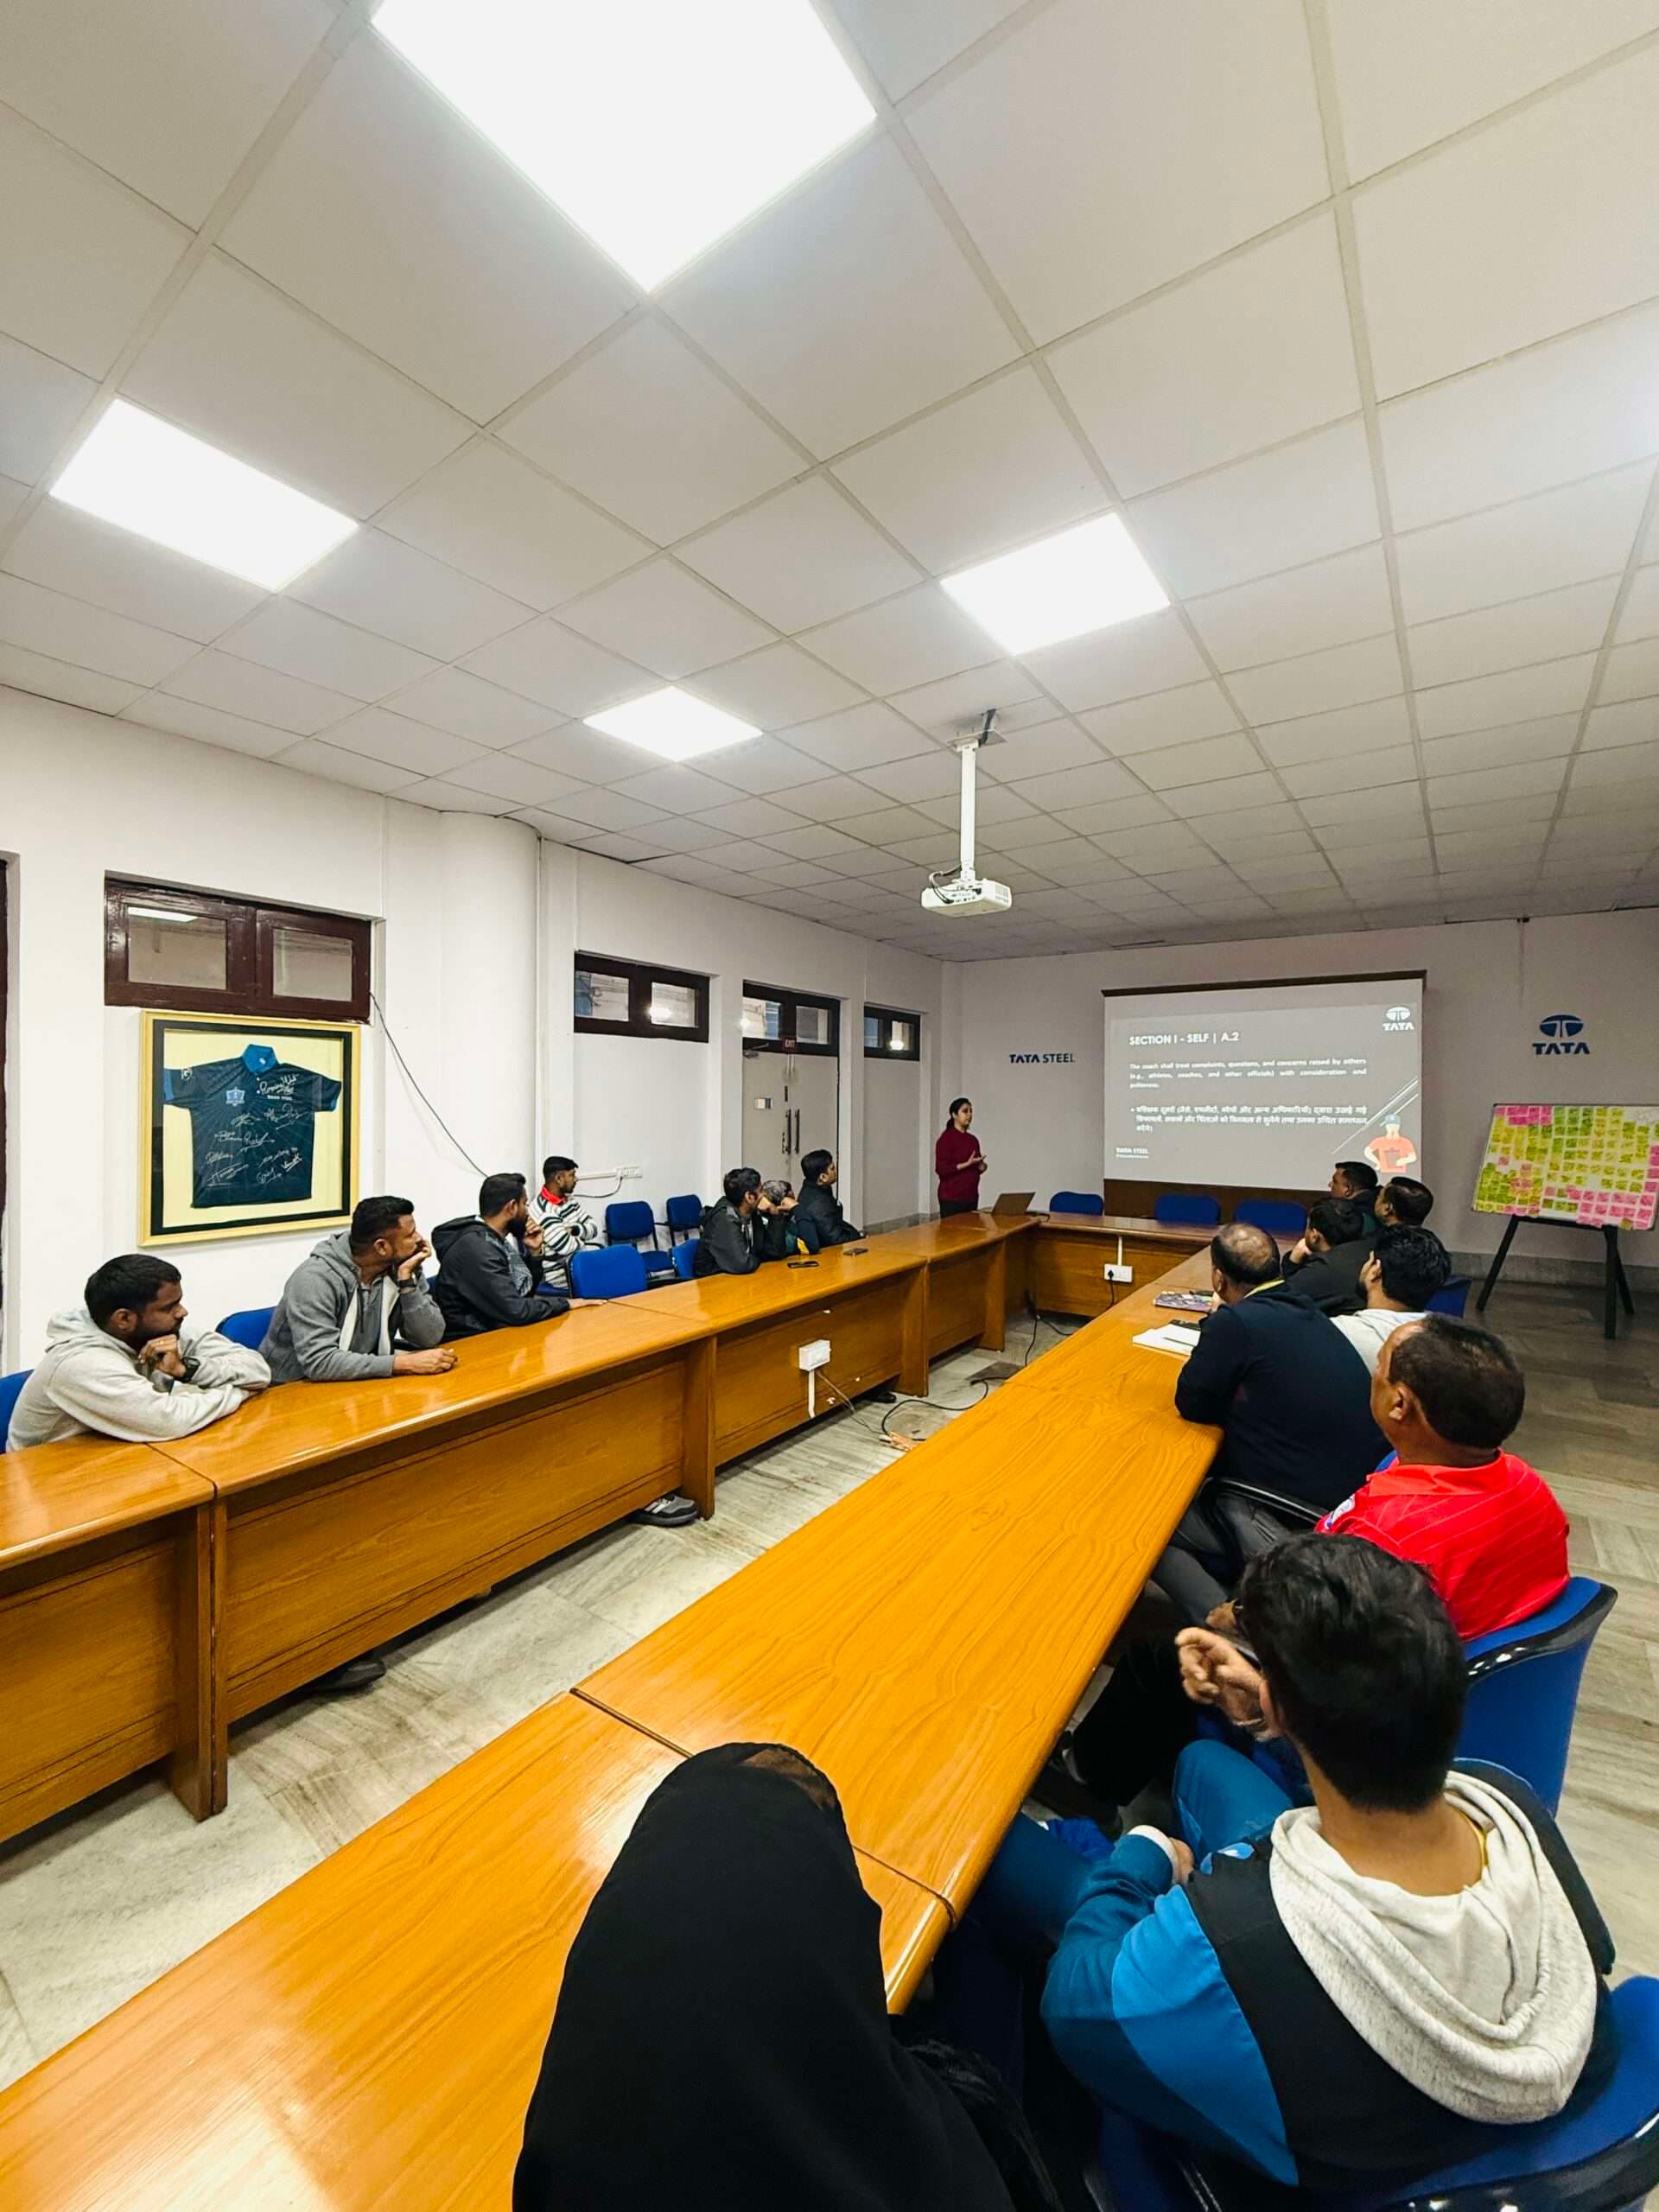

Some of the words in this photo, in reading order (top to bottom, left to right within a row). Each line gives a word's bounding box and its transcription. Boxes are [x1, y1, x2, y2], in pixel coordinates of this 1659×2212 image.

[1382, 1022, 1414, 1031] TATA
[1129, 1035, 1171, 1046] SECTION
[1186, 1033, 1210, 1043] SELF
[1221, 1032, 1240, 1042] A.2
[1532, 1042, 1591, 1055] TATA
[1009, 1053, 1040, 1064] TATA
[1042, 1053, 1076, 1064] STEEL
